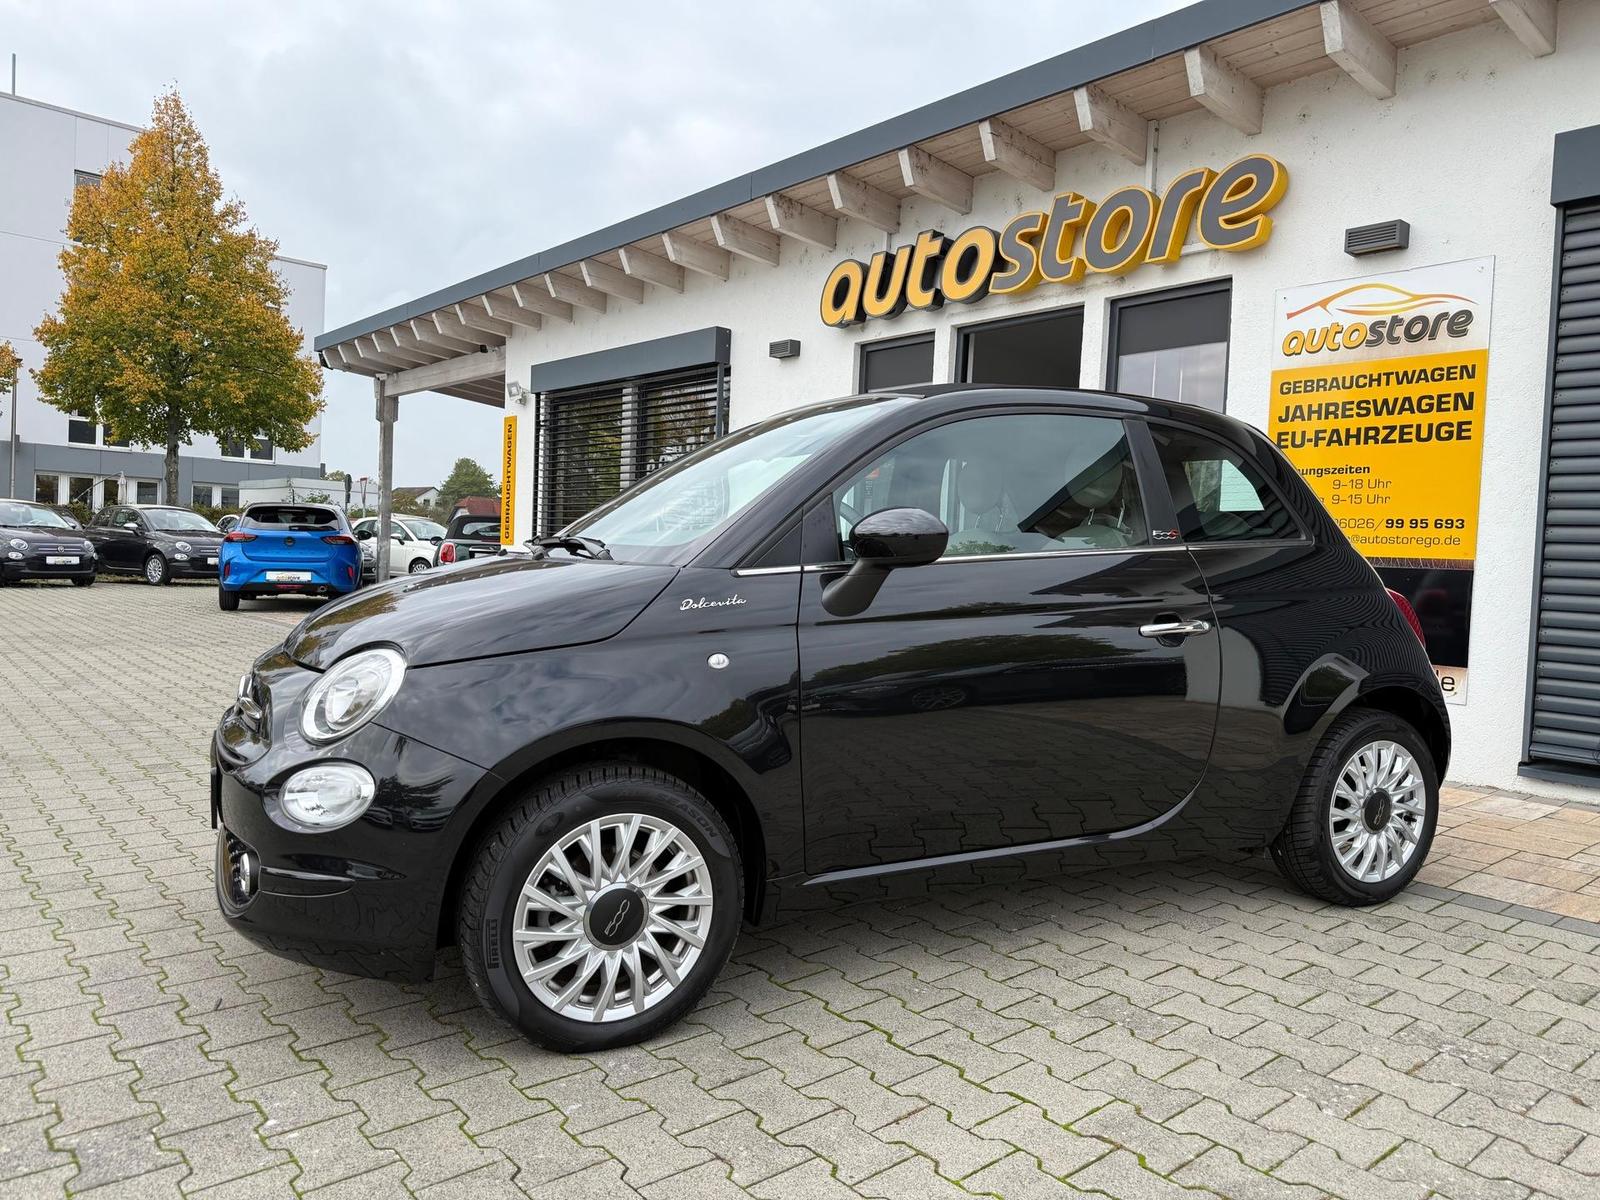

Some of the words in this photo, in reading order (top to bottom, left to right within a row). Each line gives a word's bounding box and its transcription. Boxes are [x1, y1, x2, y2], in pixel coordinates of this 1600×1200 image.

[820, 153, 1289, 328] autostore
[1282, 308, 1475, 356] autostore
[1279, 363, 1477, 395] GEBRAUCHTWAGEN
[1277, 391, 1475, 423] JAHRESWAGEN
[1276, 420, 1473, 449] EU-FAHRZEUGE
[503, 423, 513, 540] GEBRAUCHTWAGEN
[1297, 464, 1371, 478] ungszeiten
[1332, 479, 1364, 490] 9-18
[1367, 478, 1392, 489] Uhr
[1331, 494, 1363, 505] 9-15
[1366, 494, 1391, 504] Uhr
[1409, 518, 1429, 529] 95
[1434, 518, 1465, 529] 693
[1347, 534, 1461, 548] @autostorego.de
[680, 594, 747, 611] Dolcevita
